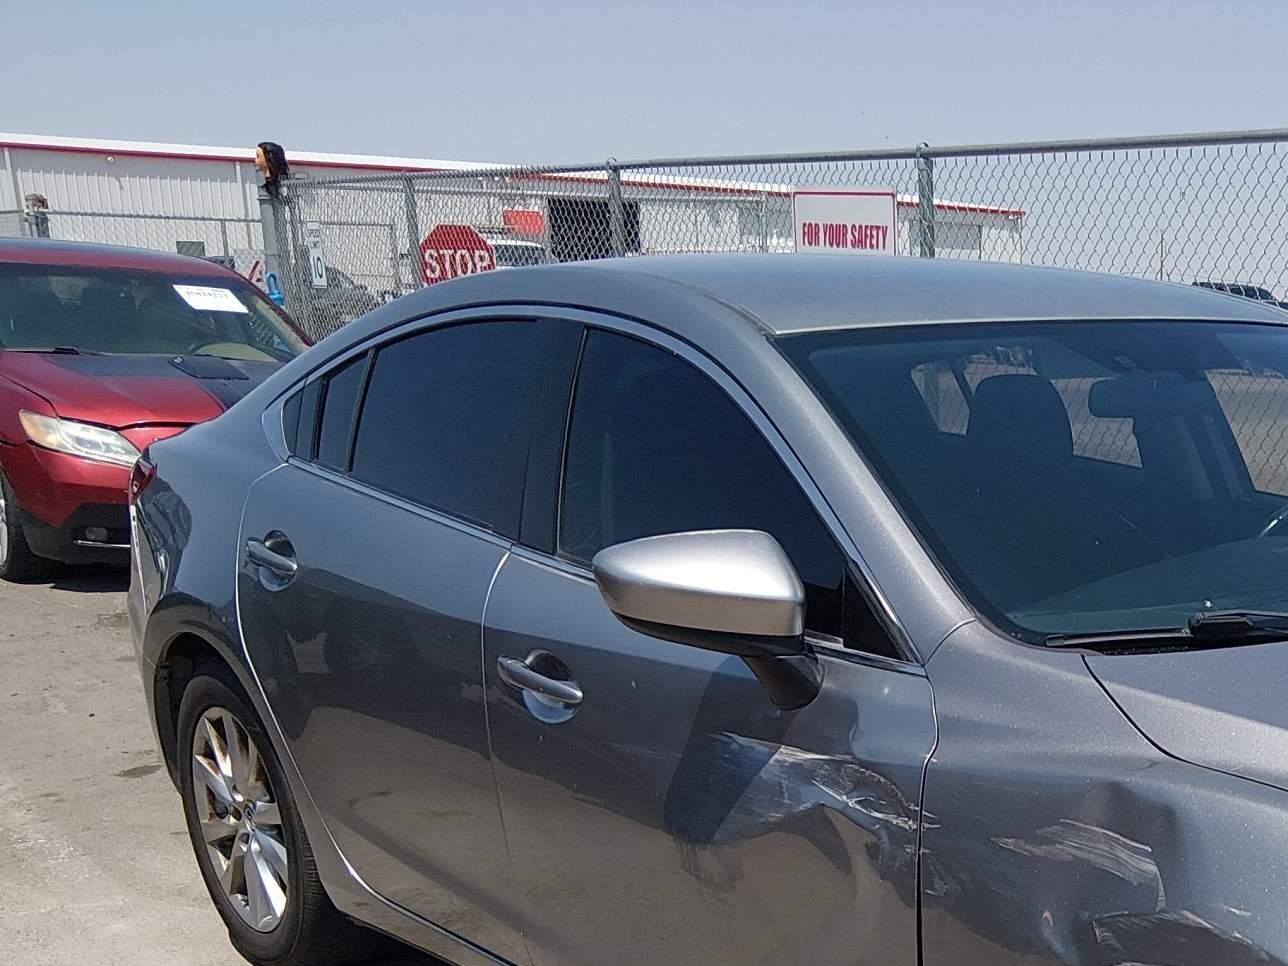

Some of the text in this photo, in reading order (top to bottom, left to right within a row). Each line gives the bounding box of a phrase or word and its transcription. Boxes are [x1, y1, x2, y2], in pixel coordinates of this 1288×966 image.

[802, 222, 888, 250] FOR YOUR SAFETY
[312, 256, 324, 279] 10
[424, 249, 491, 279] STOP
